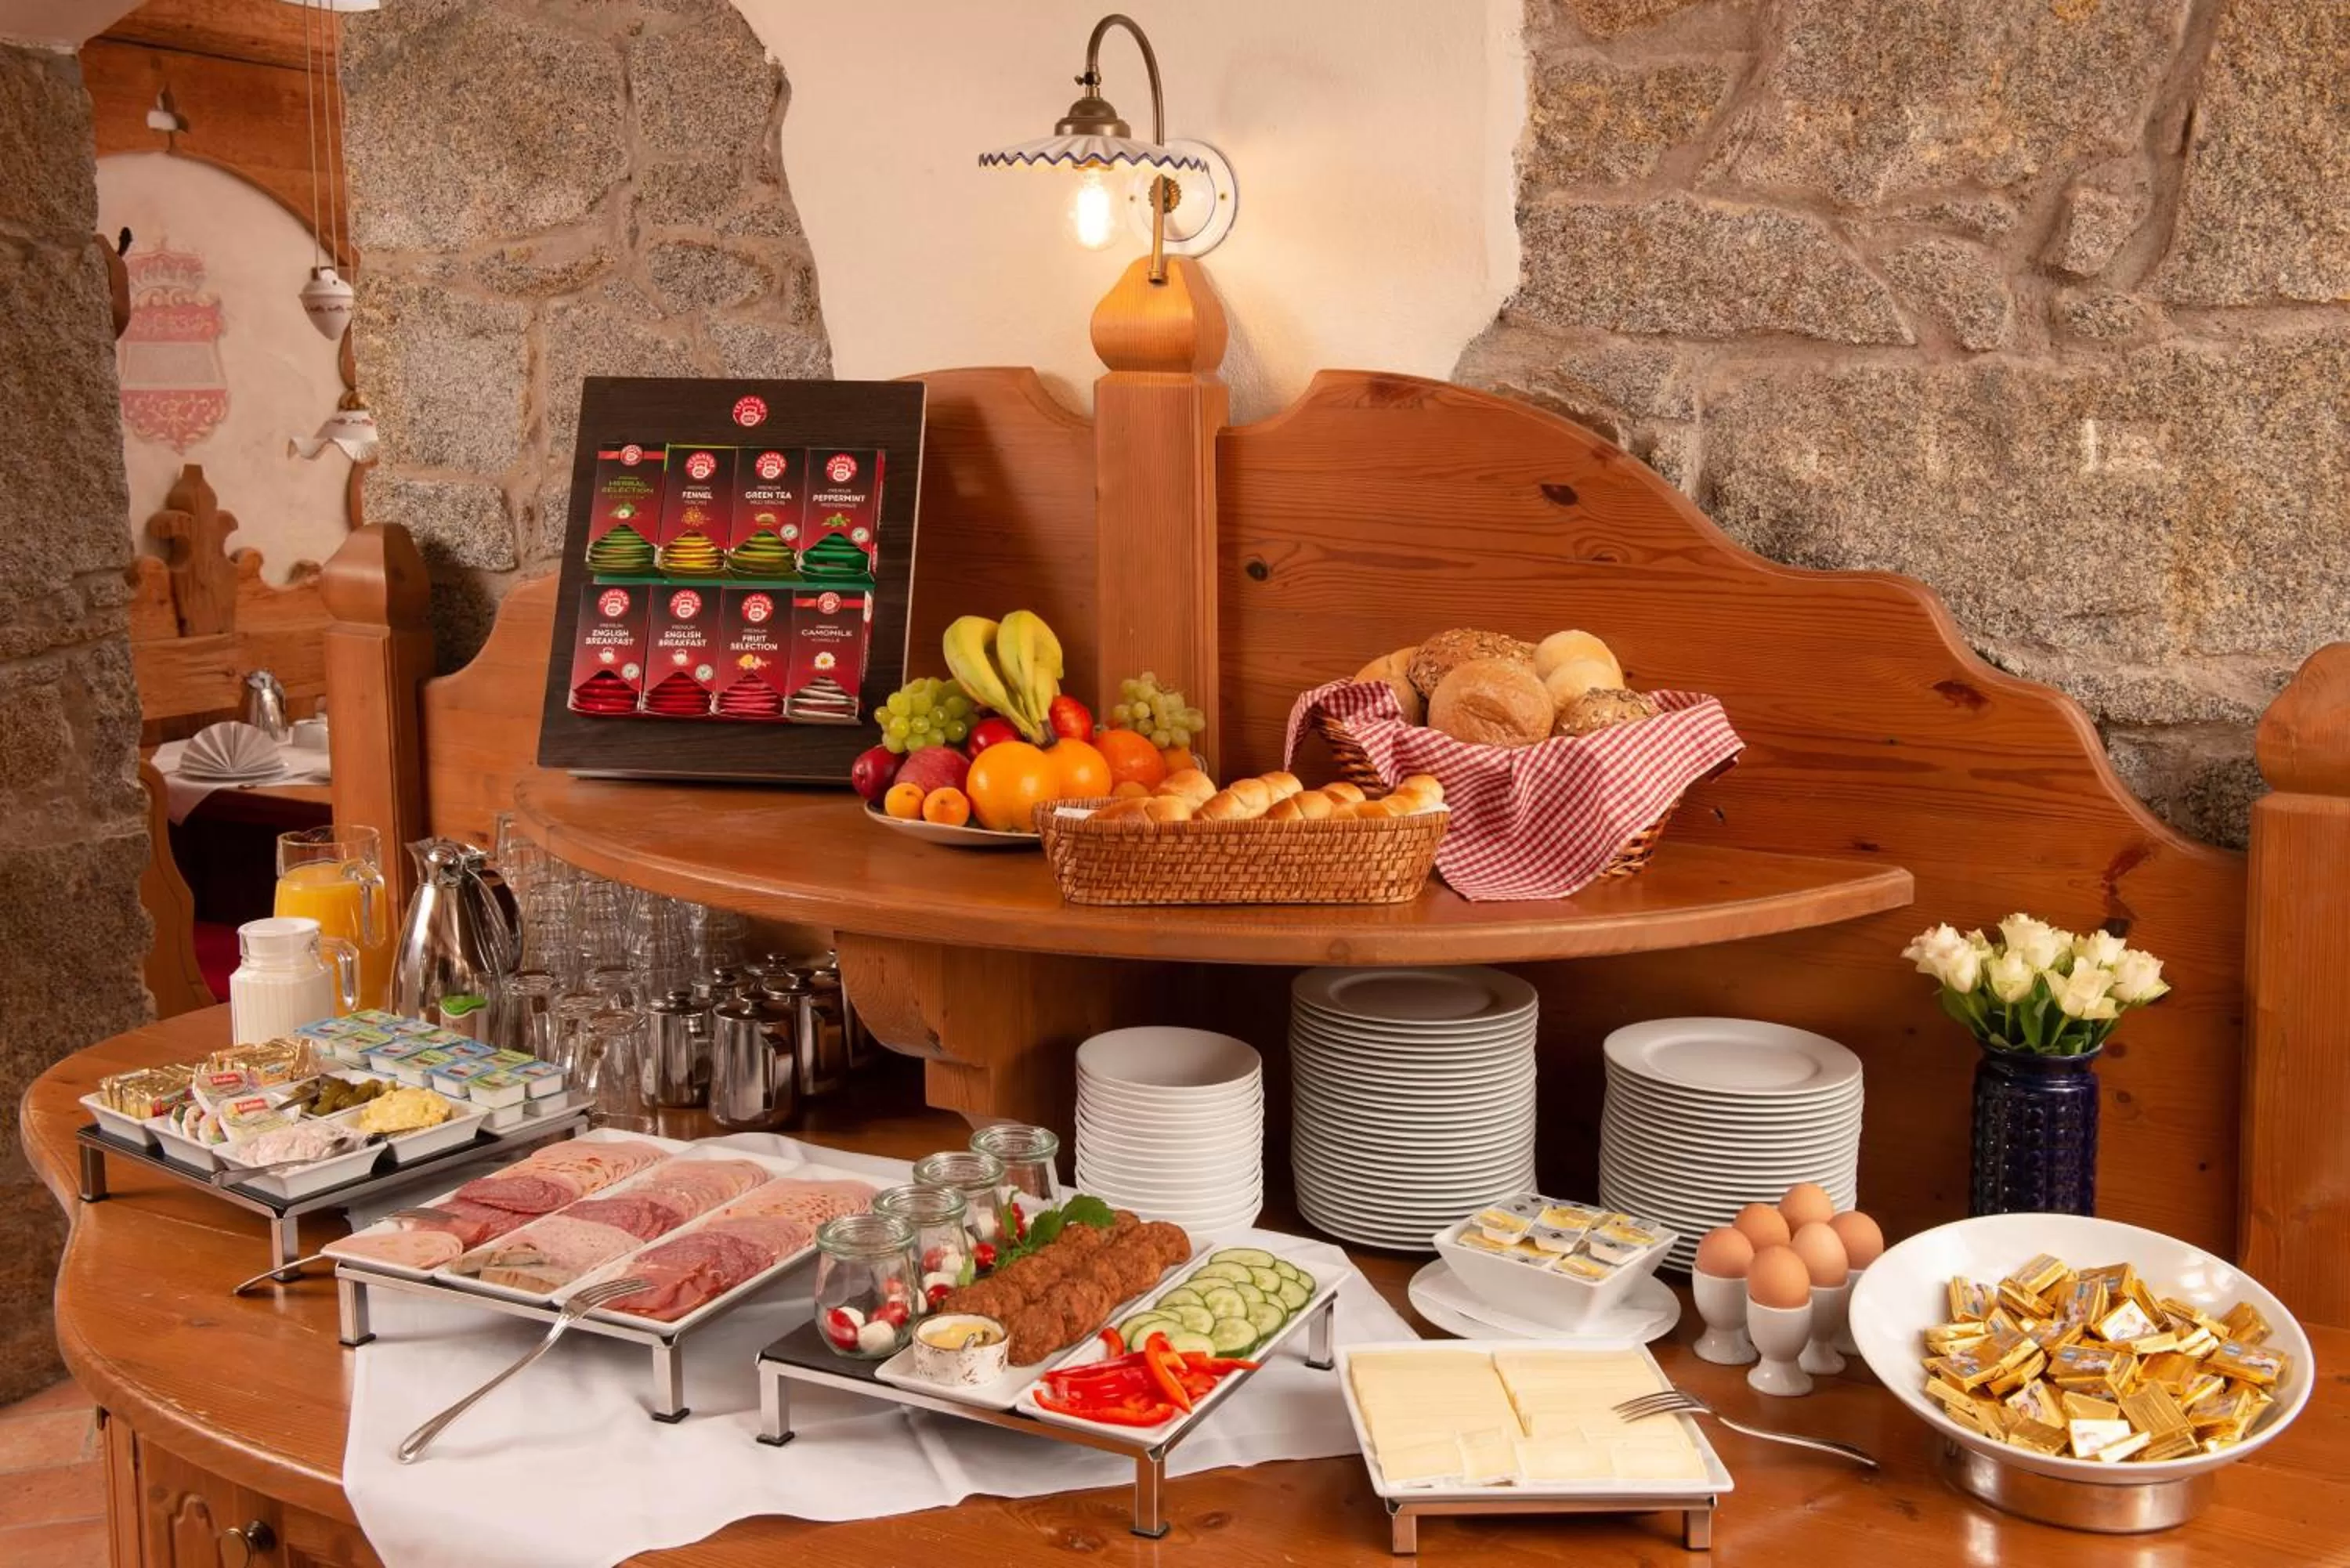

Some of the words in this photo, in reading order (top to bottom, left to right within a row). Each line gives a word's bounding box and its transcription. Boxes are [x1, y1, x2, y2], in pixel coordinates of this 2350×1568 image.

[682, 490, 714, 500] FENNEL
[745, 491, 773, 500] GREEN
[775, 491, 792, 500] TEA
[812, 494, 866, 503] PEPPERMINT
[591, 629, 629, 638] ENGLISH
[664, 630, 702, 639] ENGLISH
[585, 637, 635, 645] BREAKFAST
[658, 638, 707, 647] BREAKFAST
[729, 642, 778, 652] SELECTION
